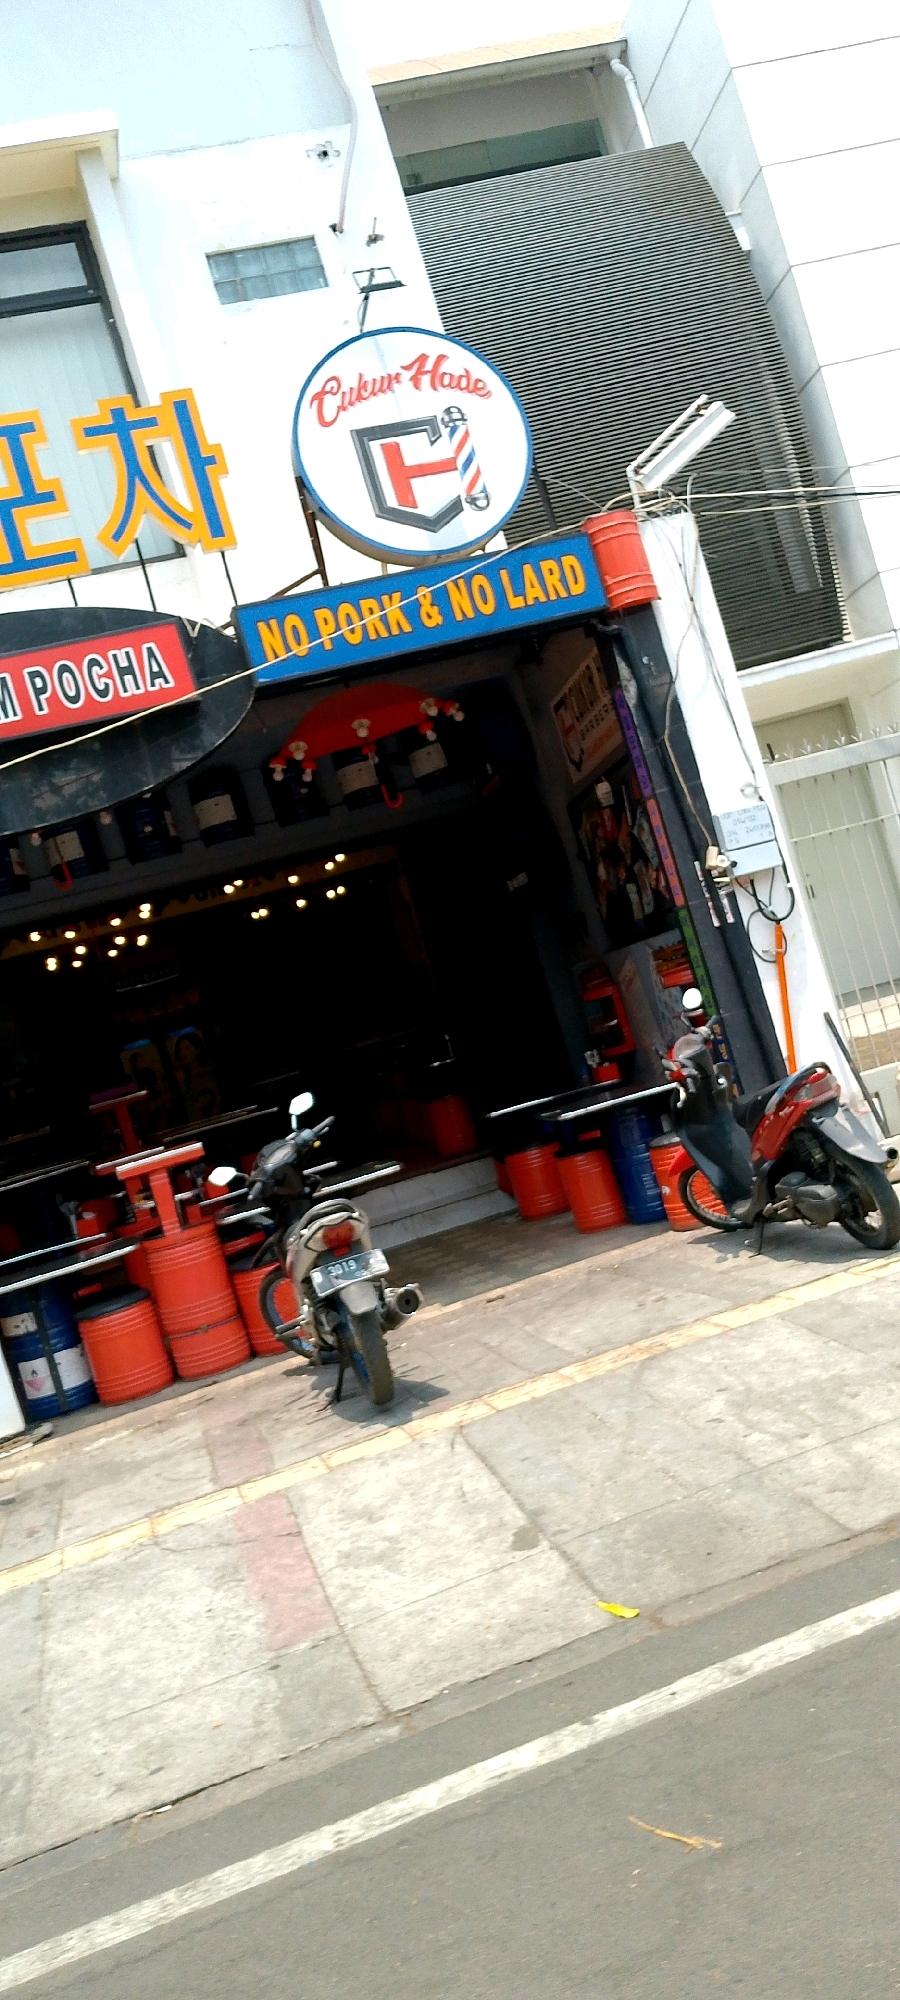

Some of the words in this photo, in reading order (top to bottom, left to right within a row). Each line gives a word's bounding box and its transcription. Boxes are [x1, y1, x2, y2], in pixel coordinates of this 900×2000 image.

[309, 374, 402, 428] Cukur
[400, 353, 492, 400] Hade
[256, 612, 310, 664] NO
[313, 590, 413, 651] PORK
[417, 584, 443, 629] &
[445, 572, 496, 623] NO
[499, 553, 587, 611] LARD
[23, 641, 175, 716] POCHA
[327, 1259, 357, 1276] 3019
